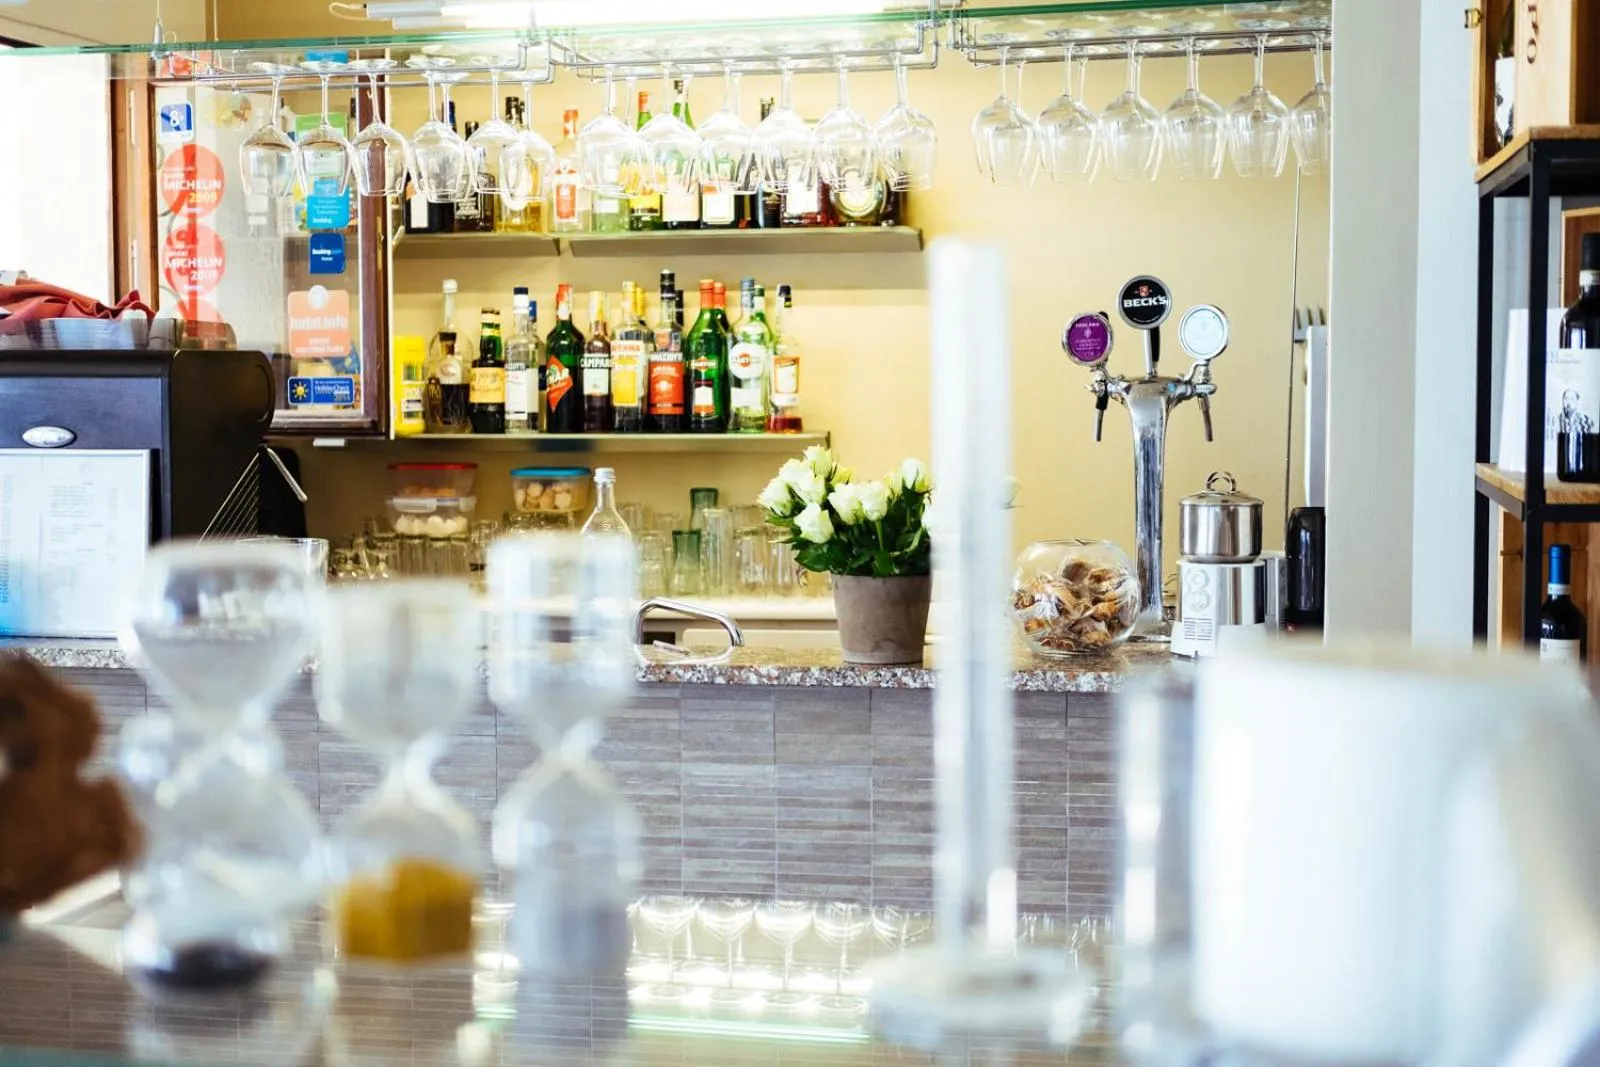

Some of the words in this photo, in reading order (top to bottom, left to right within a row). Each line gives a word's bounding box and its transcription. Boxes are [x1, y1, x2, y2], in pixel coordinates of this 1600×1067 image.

[163, 179, 222, 190] MICHELIN
[166, 256, 222, 269] MICHELIN
[1123, 295, 1168, 308] BECK'S
